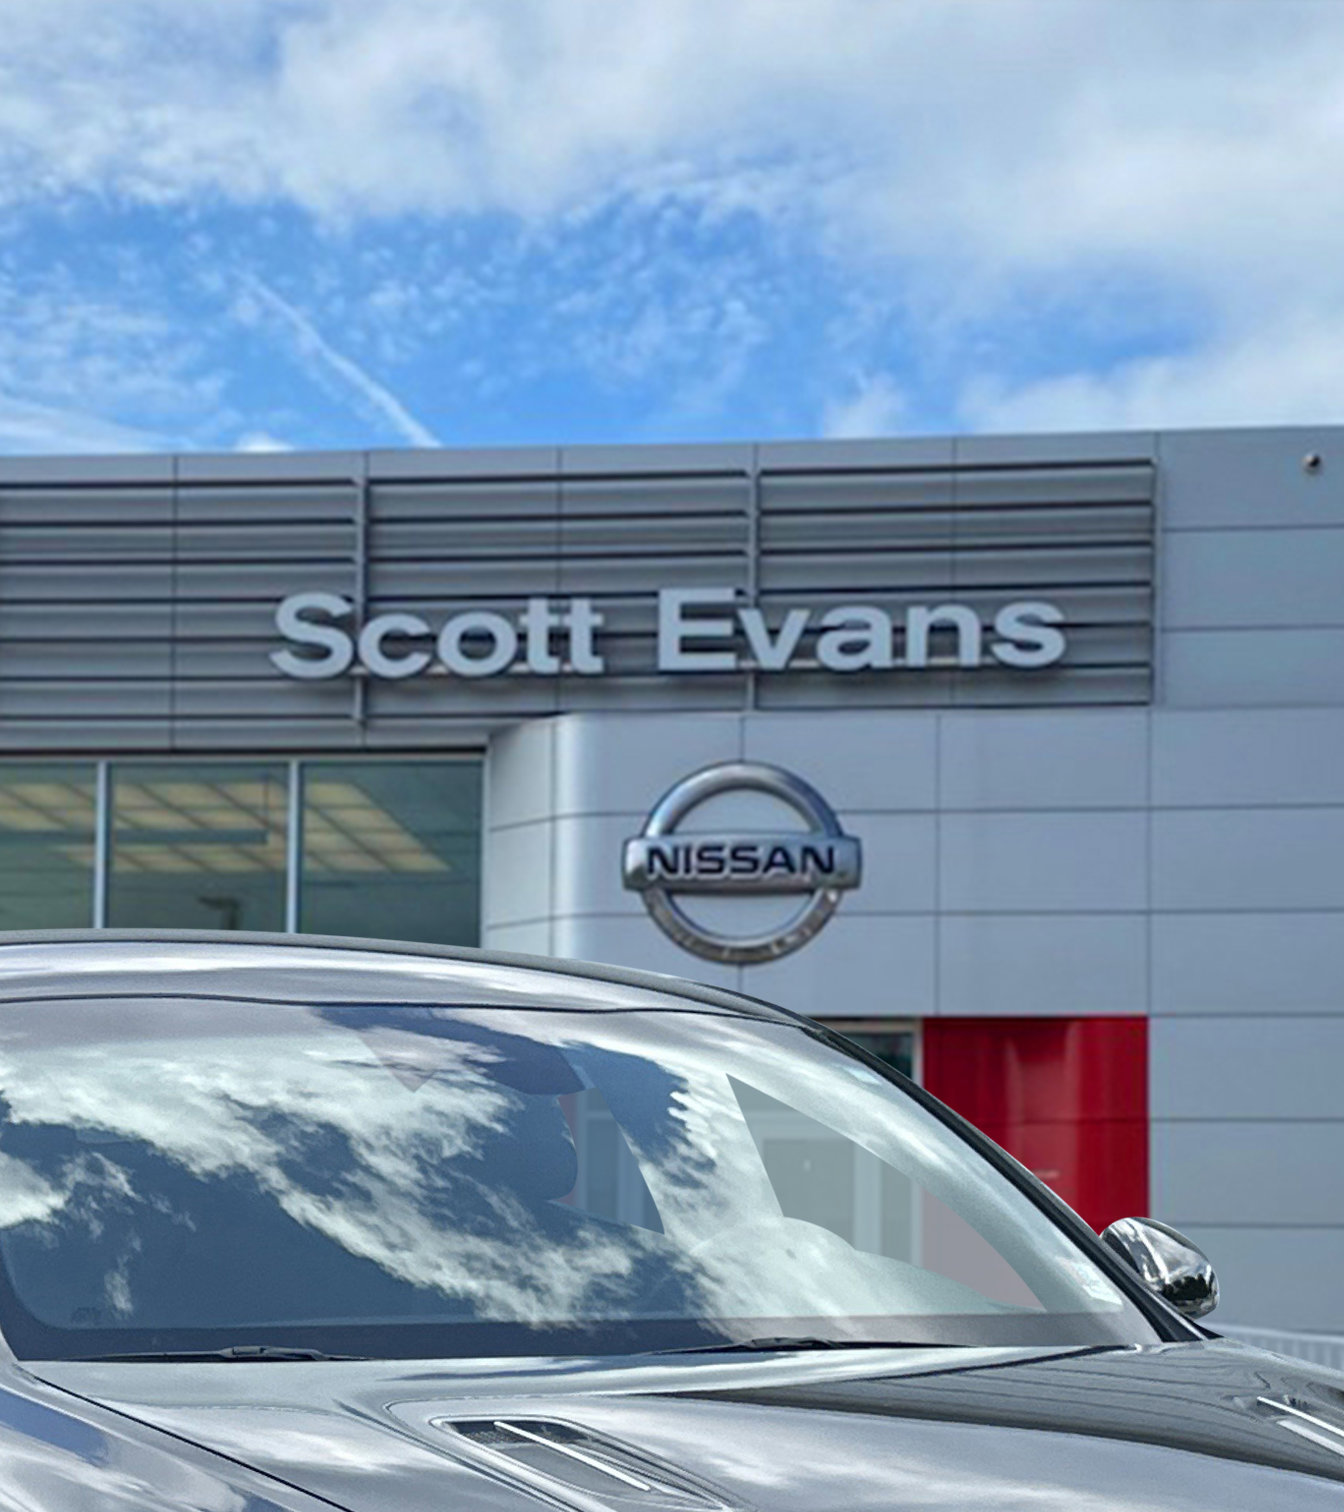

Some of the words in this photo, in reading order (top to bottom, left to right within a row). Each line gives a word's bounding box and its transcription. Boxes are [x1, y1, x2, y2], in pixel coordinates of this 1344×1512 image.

[269, 591, 605, 679] Scott
[656, 588, 1066, 673] Evans
[646, 846, 835, 876] NISSAN
